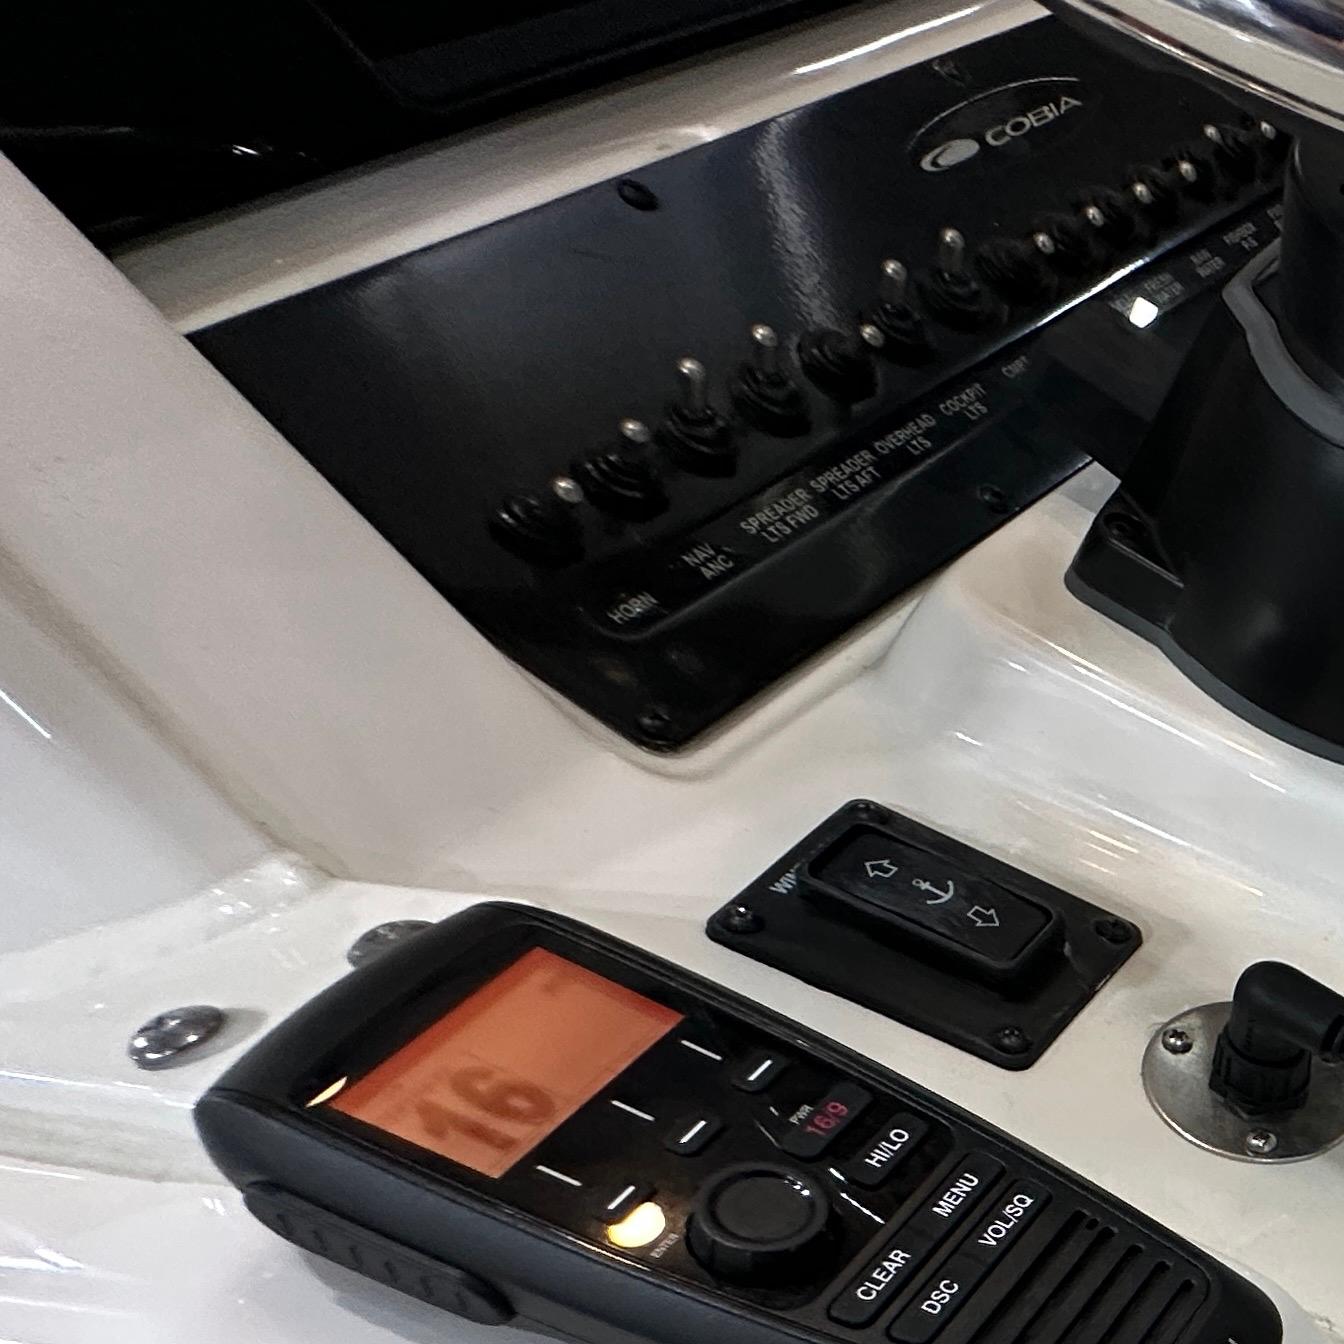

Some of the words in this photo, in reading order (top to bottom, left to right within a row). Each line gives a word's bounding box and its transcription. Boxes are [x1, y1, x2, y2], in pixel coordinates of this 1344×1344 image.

[985, 96, 1083, 147] COBIA
[939, 383, 987, 416] COCKPIT
[964, 401, 989, 420] LTS
[873, 413, 937, 454] OVERHEAD
[907, 436, 933, 456] LTS
[809, 449, 878, 494] SPREADER
[829, 479, 860, 500] LTS
[856, 465, 882, 492] AFT
[740, 488, 814, 536] SPREADER
[760, 516, 791, 543] LTS
[787, 505, 820, 532] FWD
[681, 542, 717, 568] NAV
[700, 554, 734, 581] ANC
[606, 591, 660, 625] HORN
[415, 1065, 557, 1152] 16
[788, 1103, 815, 1127] PWR
[804, 1101, 849, 1138] 16/9
[864, 1128, 909, 1168] HI/LO
[932, 1173, 979, 1218] MENU
[978, 1194, 1034, 1247] VOL/SQ
[856, 1249, 912, 1302] CLEAR
[921, 1279, 960, 1315] DSC
